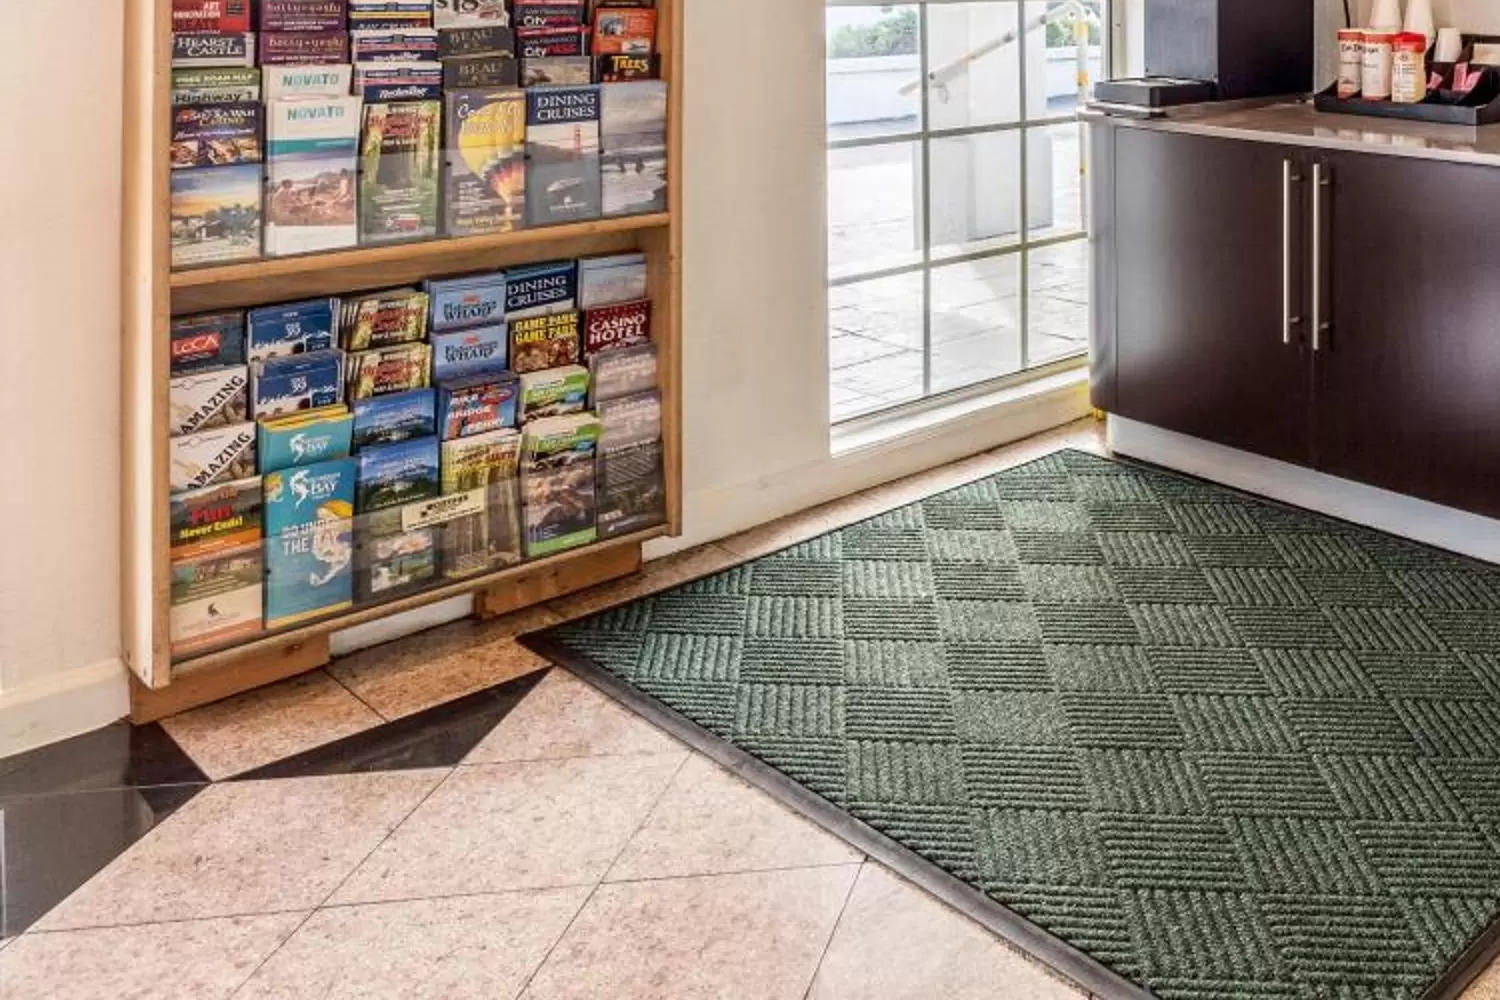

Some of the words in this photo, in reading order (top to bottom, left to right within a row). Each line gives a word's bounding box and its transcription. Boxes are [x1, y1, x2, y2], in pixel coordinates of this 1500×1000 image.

[176, 36, 236, 50] HEARST
[186, 46, 244, 57] CASTLE
[611, 55, 649, 73] TREES
[282, 73, 339, 88] NOVATO
[174, 91, 243, 104] Highway
[537, 92, 596, 108] DINING
[287, 105, 344, 121] NOVATO
[536, 105, 596, 121] CRUISES
[507, 275, 568, 296] DINING
[507, 287, 568, 308] CRUISES
[444, 305, 494, 321] WHARF
[589, 313, 646, 333] CASINO
[589, 326, 645, 345] HOTEL
[445, 346, 496, 363] WHARF
[180, 374, 245, 435] AMAZING
[186, 431, 251, 490] AMAZING
[311, 481, 338, 495] BAY
[190, 504, 233, 525] Fun
[179, 525, 212, 539] Never
[213, 516, 243, 534] Ends!
[281, 536, 310, 556] THE
